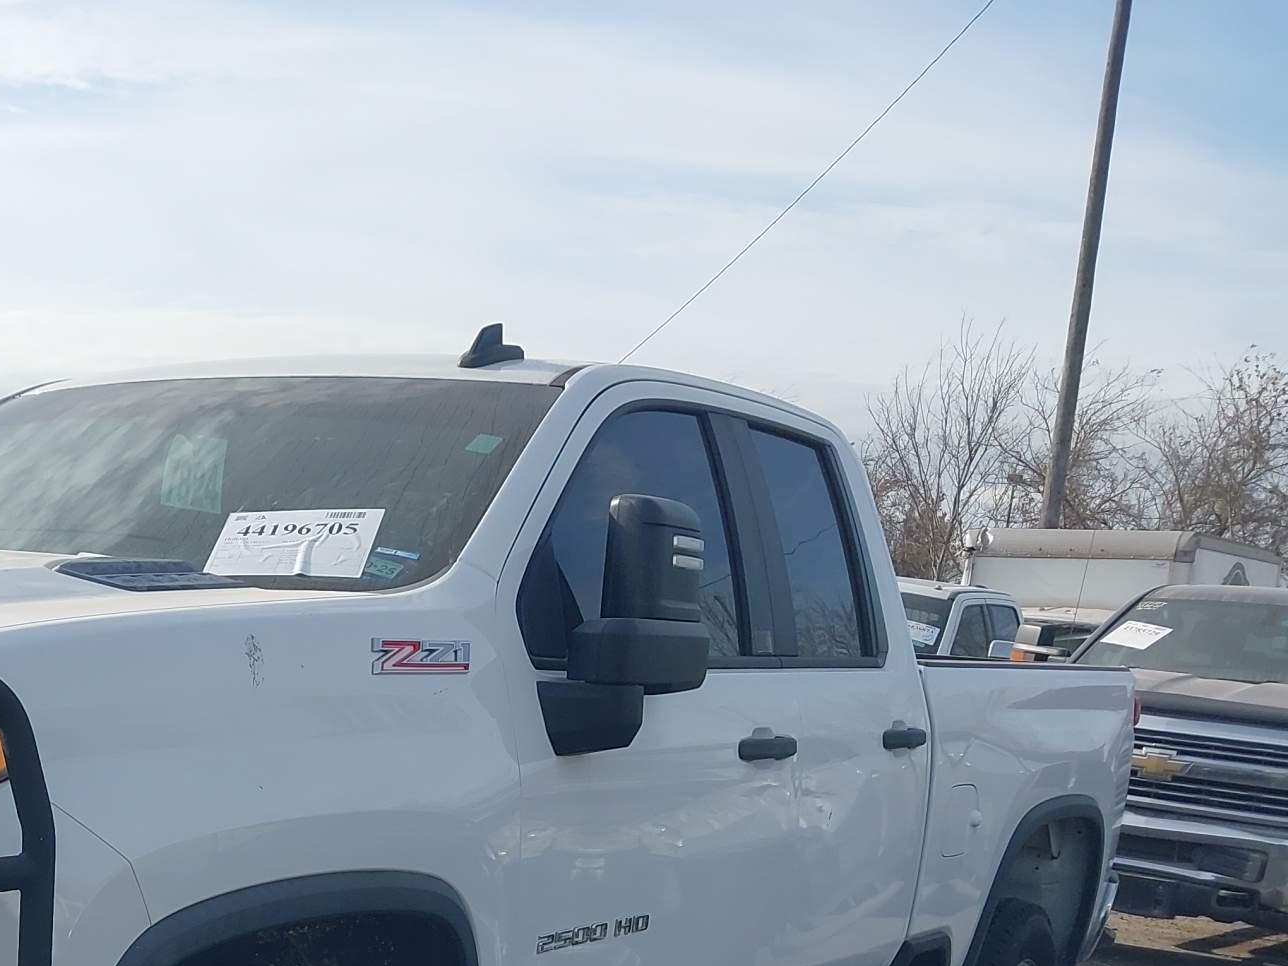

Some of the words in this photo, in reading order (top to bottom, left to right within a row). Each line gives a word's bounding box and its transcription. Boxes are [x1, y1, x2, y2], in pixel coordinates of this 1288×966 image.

[236, 522, 360, 536] 44196705
[371, 637, 471, 675] Z71
[536, 922, 608, 954] 2500
[614, 914, 650, 938] HD
